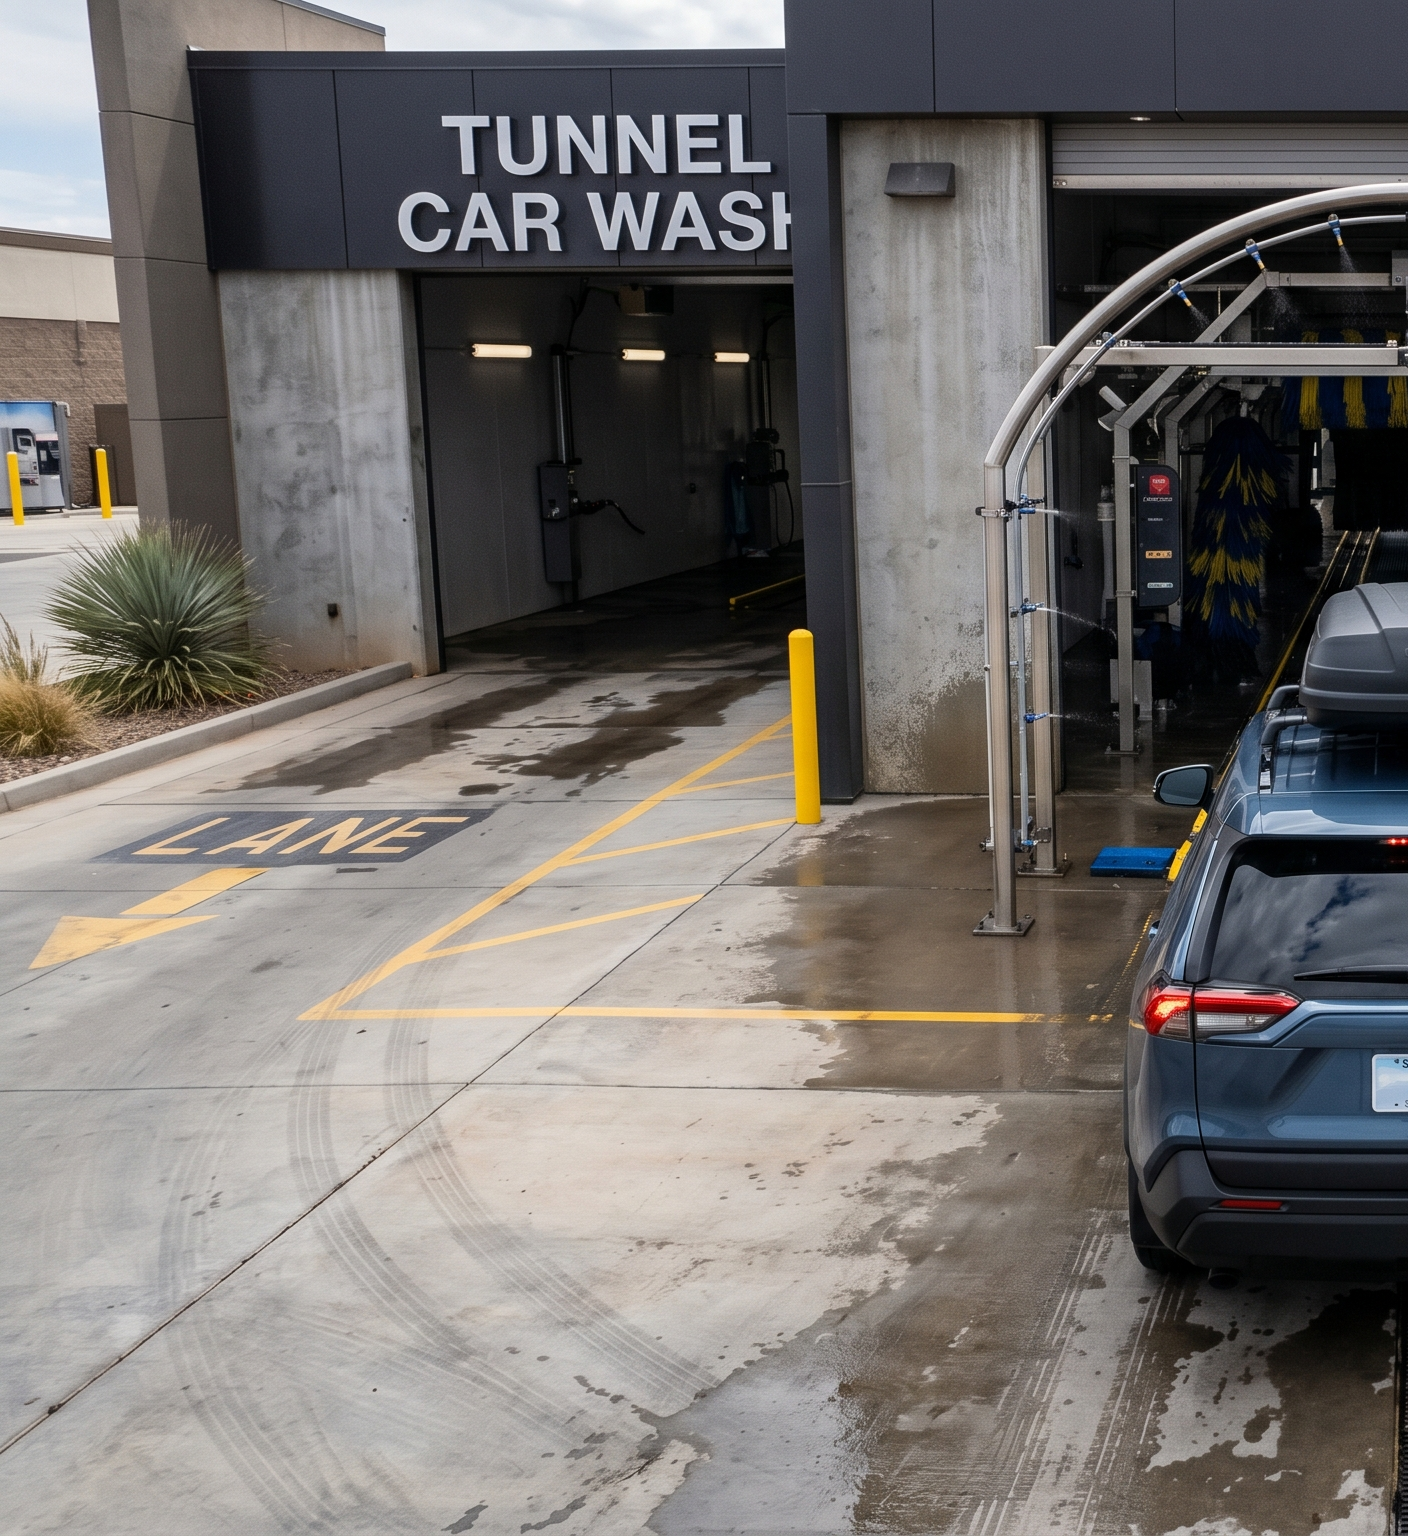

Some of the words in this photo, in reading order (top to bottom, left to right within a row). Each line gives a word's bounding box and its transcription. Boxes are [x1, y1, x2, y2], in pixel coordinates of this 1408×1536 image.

[441, 114, 772, 176] TUNNEL
[398, 191, 562, 253] CAR
[131, 817, 470, 855] LANE
